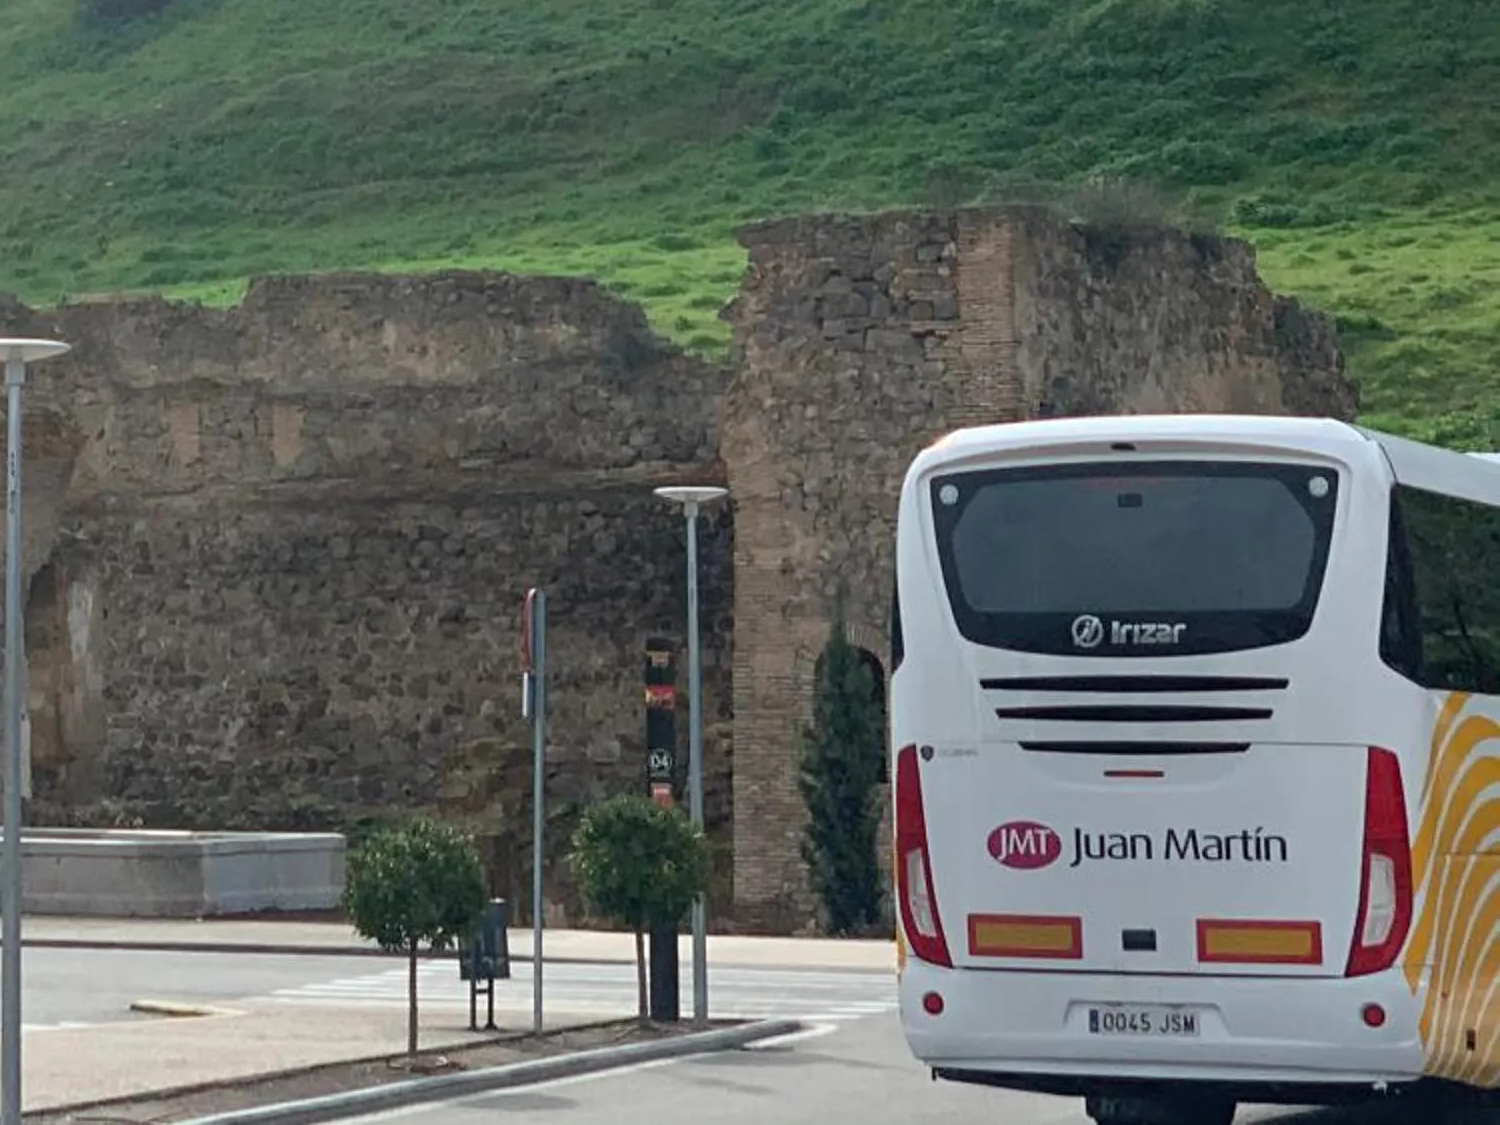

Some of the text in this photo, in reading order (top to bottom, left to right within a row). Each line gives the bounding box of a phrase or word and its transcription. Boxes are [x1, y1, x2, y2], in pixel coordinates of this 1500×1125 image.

[1111, 620, 1187, 645] Irizar
[998, 828, 1051, 861] JMT
[1069, 826, 1288, 868] Juan Martín
[1102, 1012, 1196, 1034] 0045 JSM
